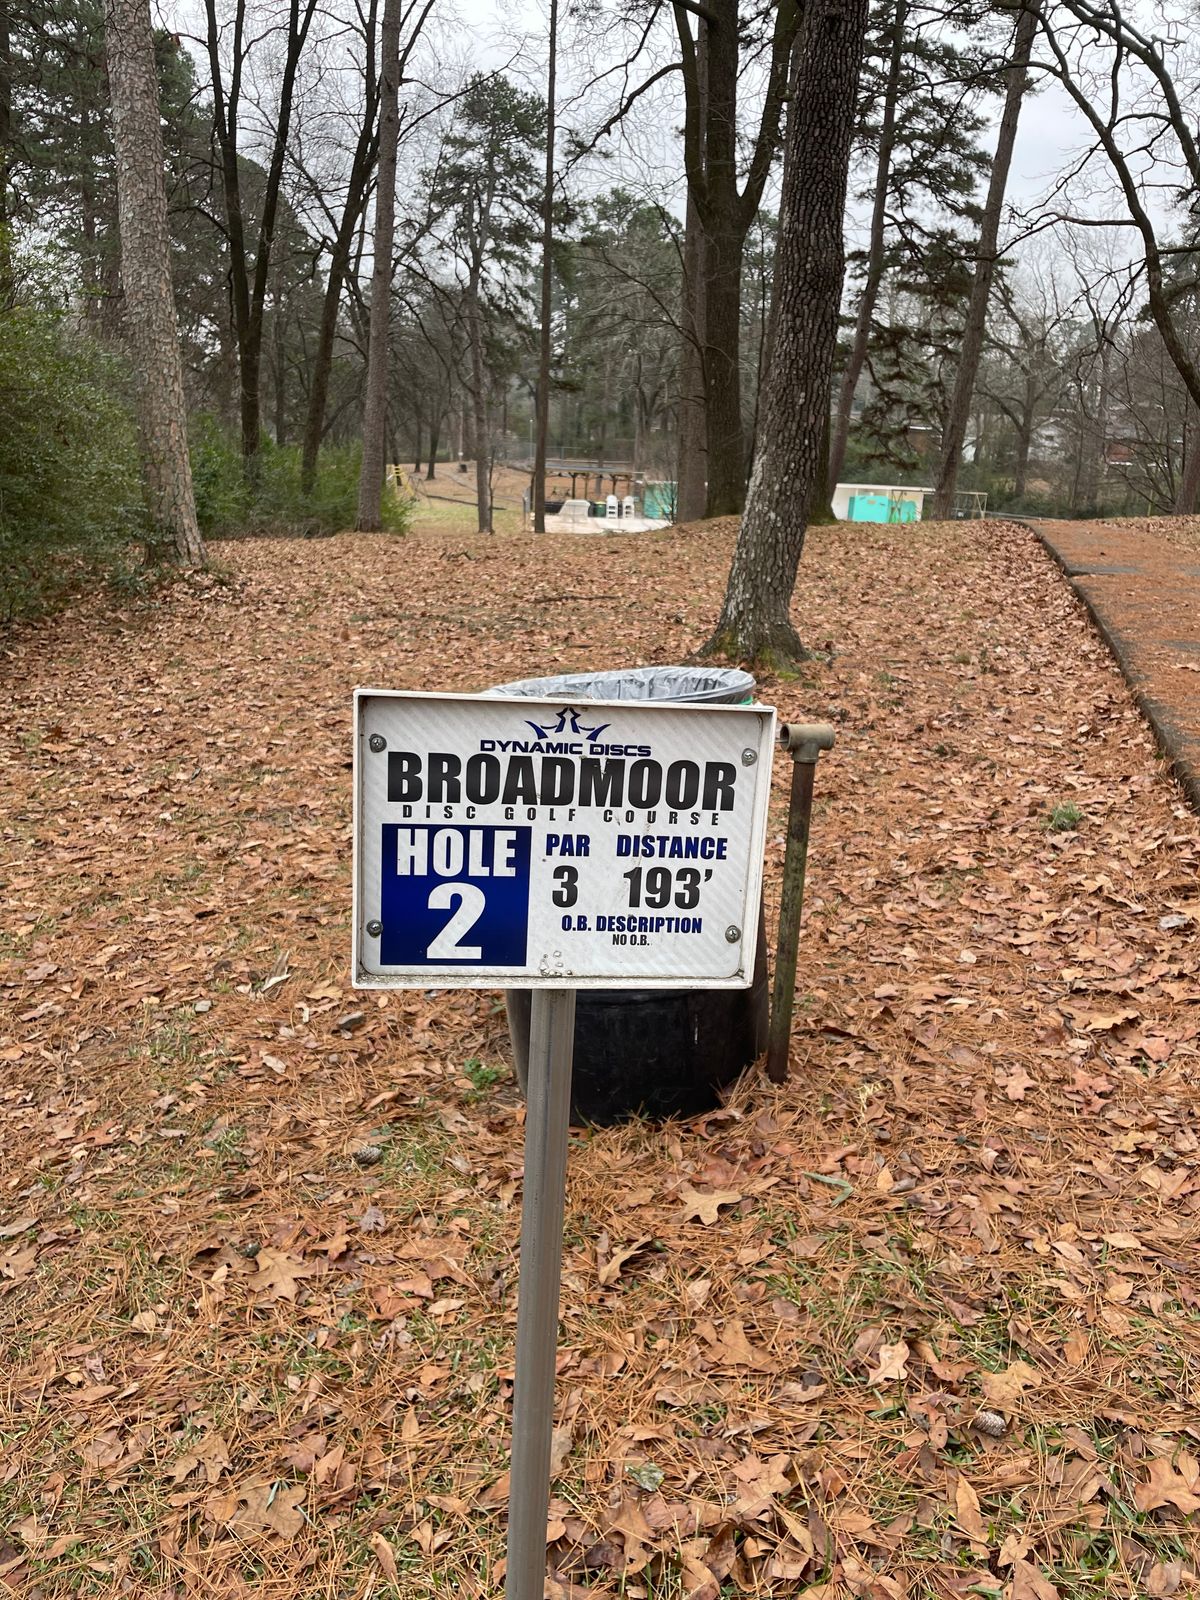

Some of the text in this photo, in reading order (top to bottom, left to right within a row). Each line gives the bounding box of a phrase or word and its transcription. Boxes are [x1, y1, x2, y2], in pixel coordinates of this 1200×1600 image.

[480, 739, 651, 757] DYNAMIC DISCS
[387, 751, 737, 811] BROADMOOR
[402, 805, 720, 826] DISC GOLF COURSE
[396, 828, 517, 877] HOLE
[546, 834, 727, 860] PAR DISTANCE
[552, 865, 579, 908] 3
[426, 882, 486, 959] 2
[561, 915, 702, 933] O.B. DESCRIPTION
[612, 934, 650, 946] NO O.B.
